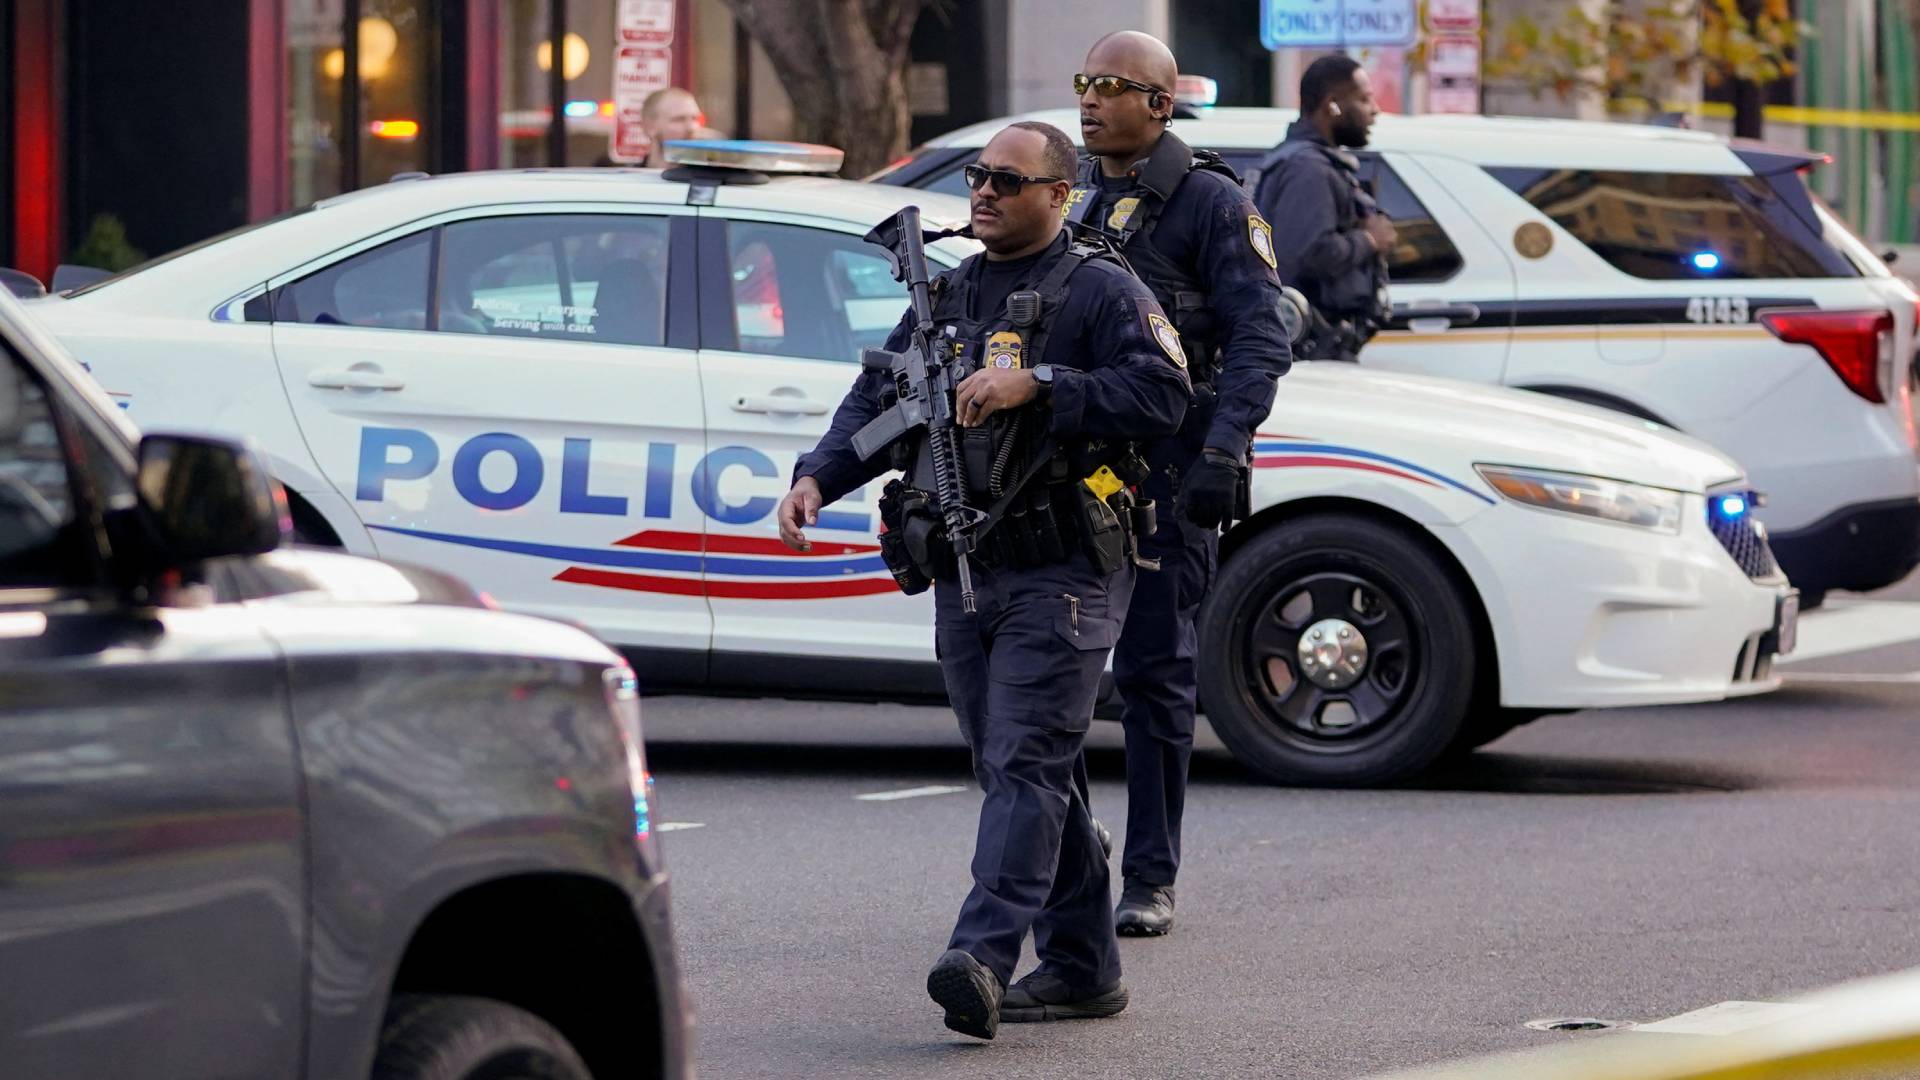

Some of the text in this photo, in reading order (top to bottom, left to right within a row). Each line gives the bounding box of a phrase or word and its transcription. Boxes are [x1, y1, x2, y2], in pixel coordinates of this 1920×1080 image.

[1279, 11, 1337, 34] ONLY
[1348, 12, 1405, 34] ONLY
[1066, 189, 1088, 203] ICE
[1685, 297, 1749, 324] 4143
[493, 318, 541, 332] Serving
[567, 323, 597, 334] care.
